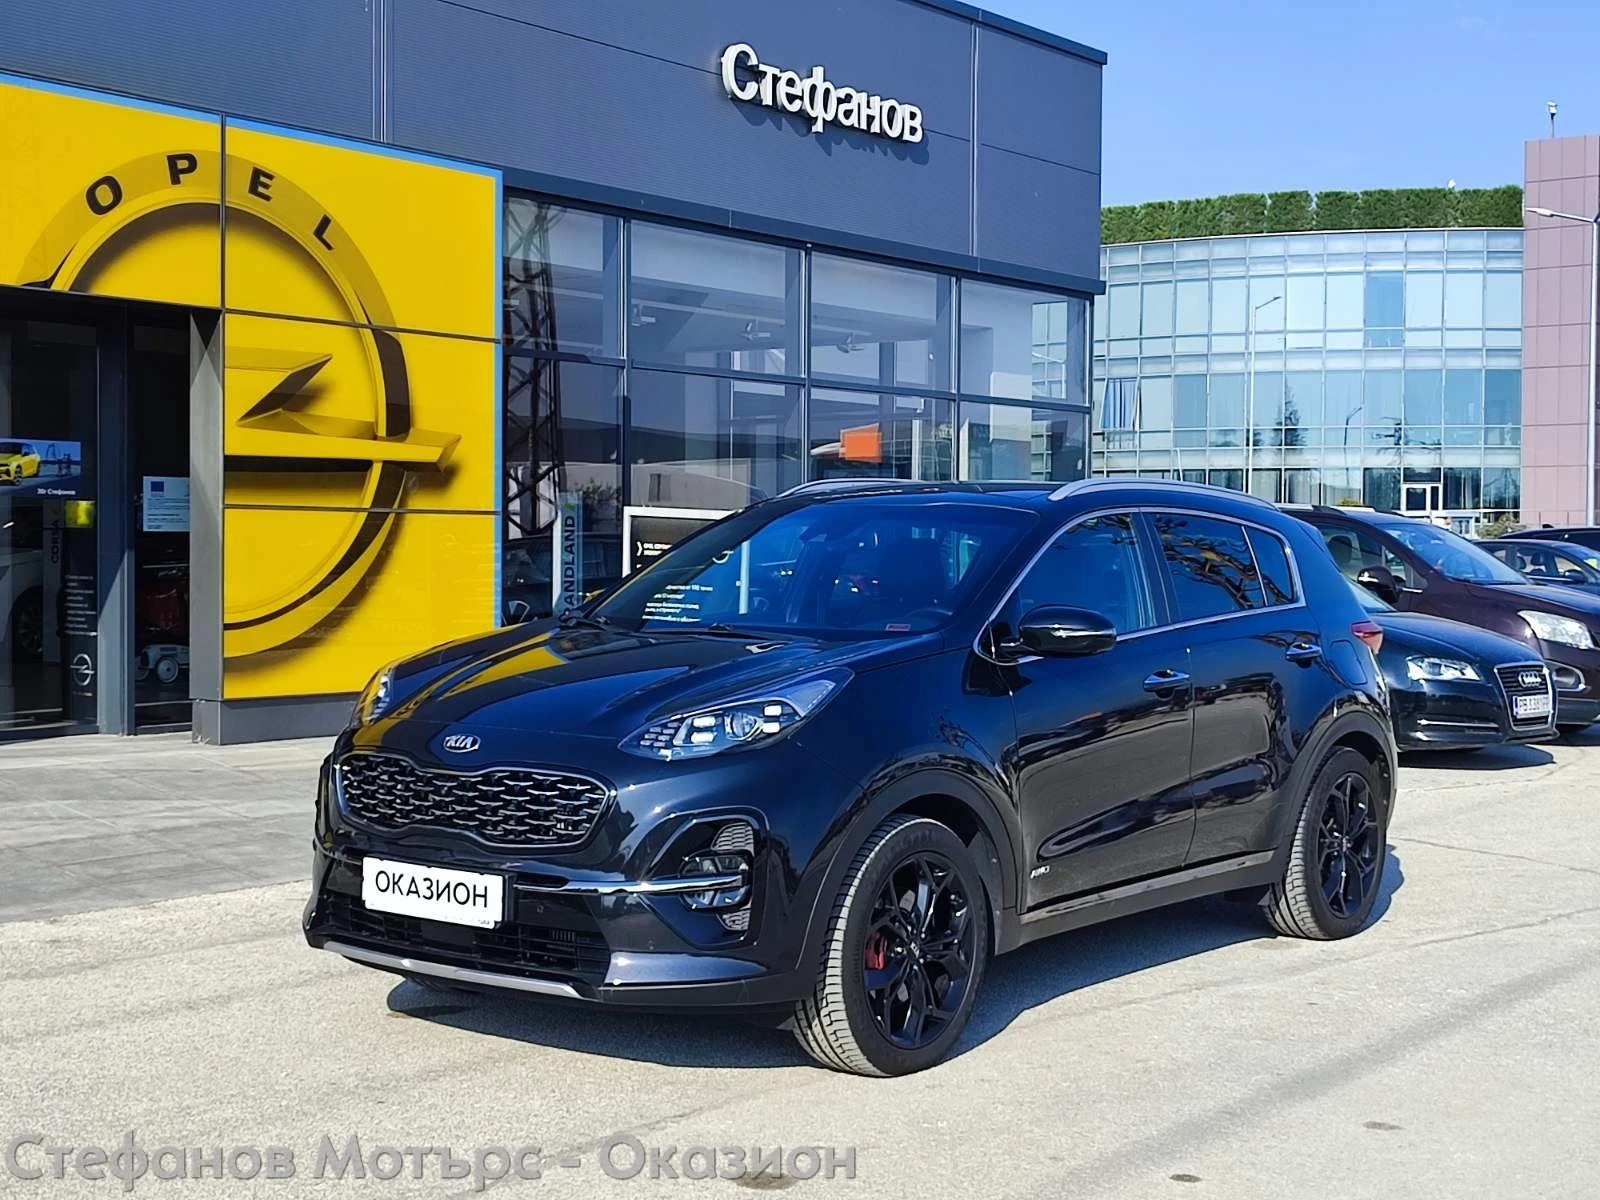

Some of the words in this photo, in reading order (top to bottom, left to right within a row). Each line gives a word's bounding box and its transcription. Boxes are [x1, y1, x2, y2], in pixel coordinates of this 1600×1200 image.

[721, 43, 924, 143] Стефанов
[85, 153, 335, 251] OPEL
[564, 515, 577, 610] ANDLAND
[445, 735, 474, 749] KIA
[375, 870, 489, 908] ОКАЗИОН
